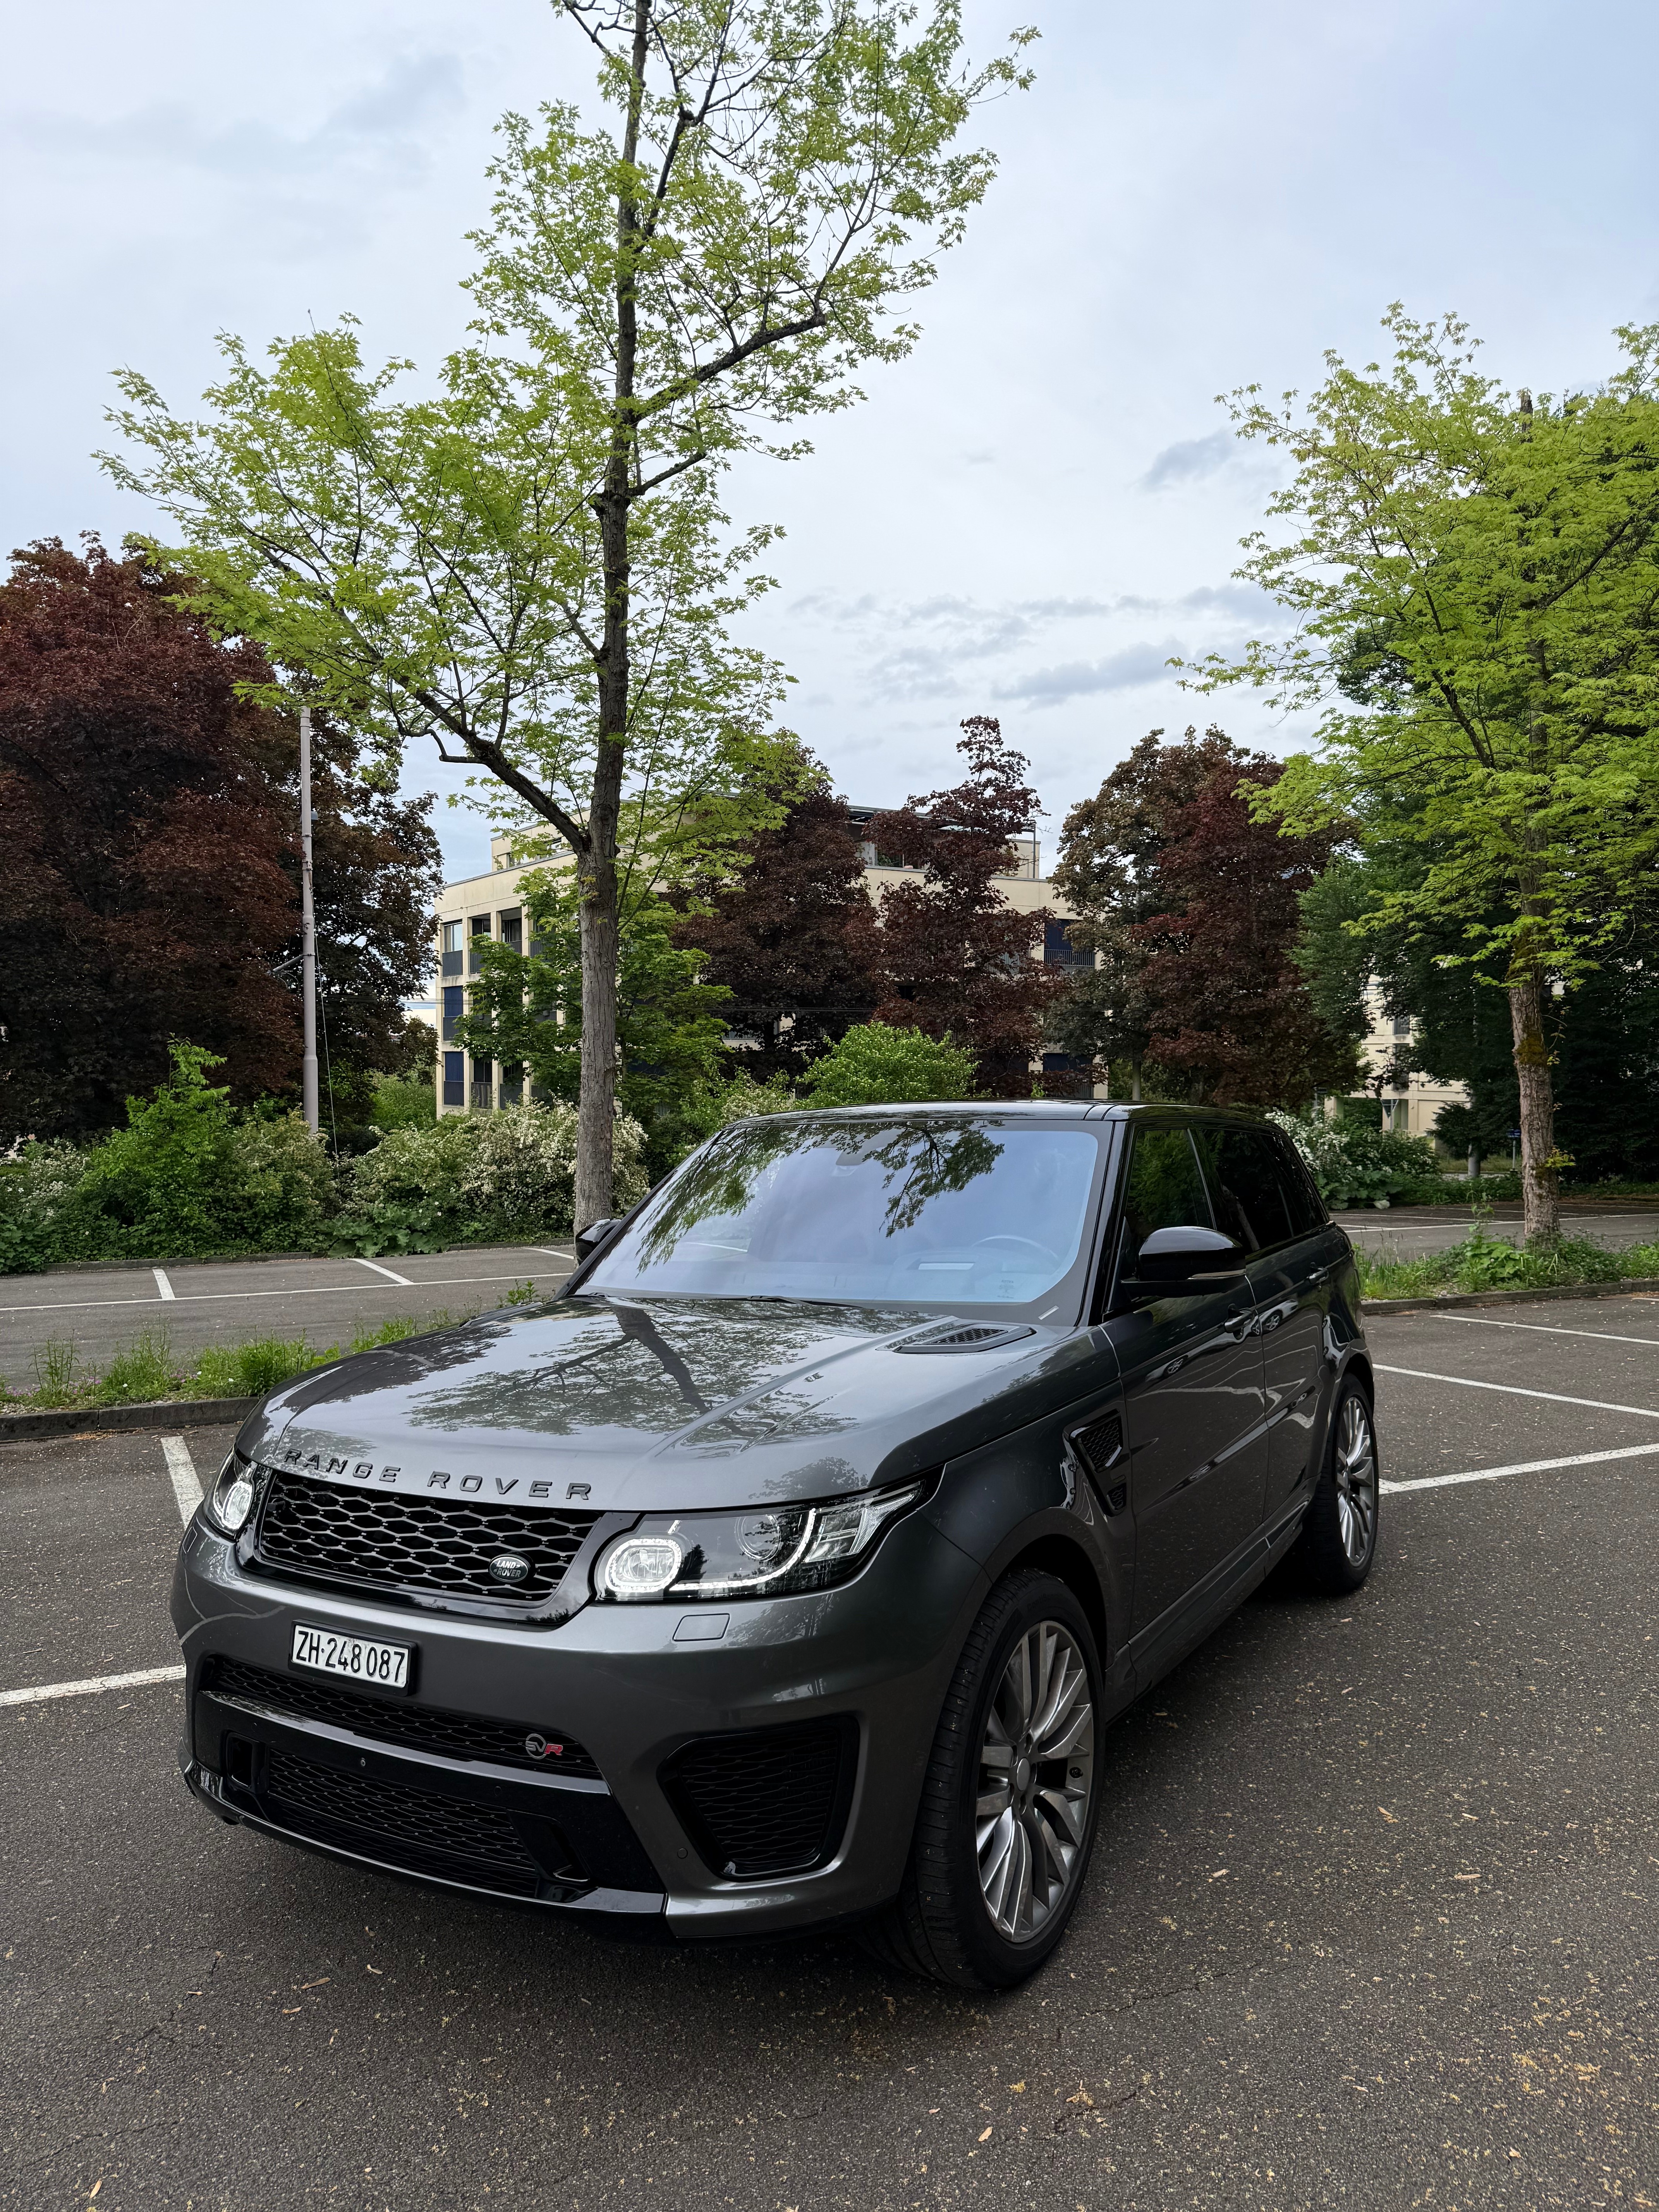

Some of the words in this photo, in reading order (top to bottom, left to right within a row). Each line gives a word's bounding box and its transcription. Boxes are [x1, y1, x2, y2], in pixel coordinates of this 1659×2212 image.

[283, 1448, 401, 1482] RANGE
[427, 1471, 591, 1500] ROVER
[496, 1560, 516, 1569] LAND
[496, 1568, 521, 1577] ROVER
[526, 1733, 563, 1759] SVR
